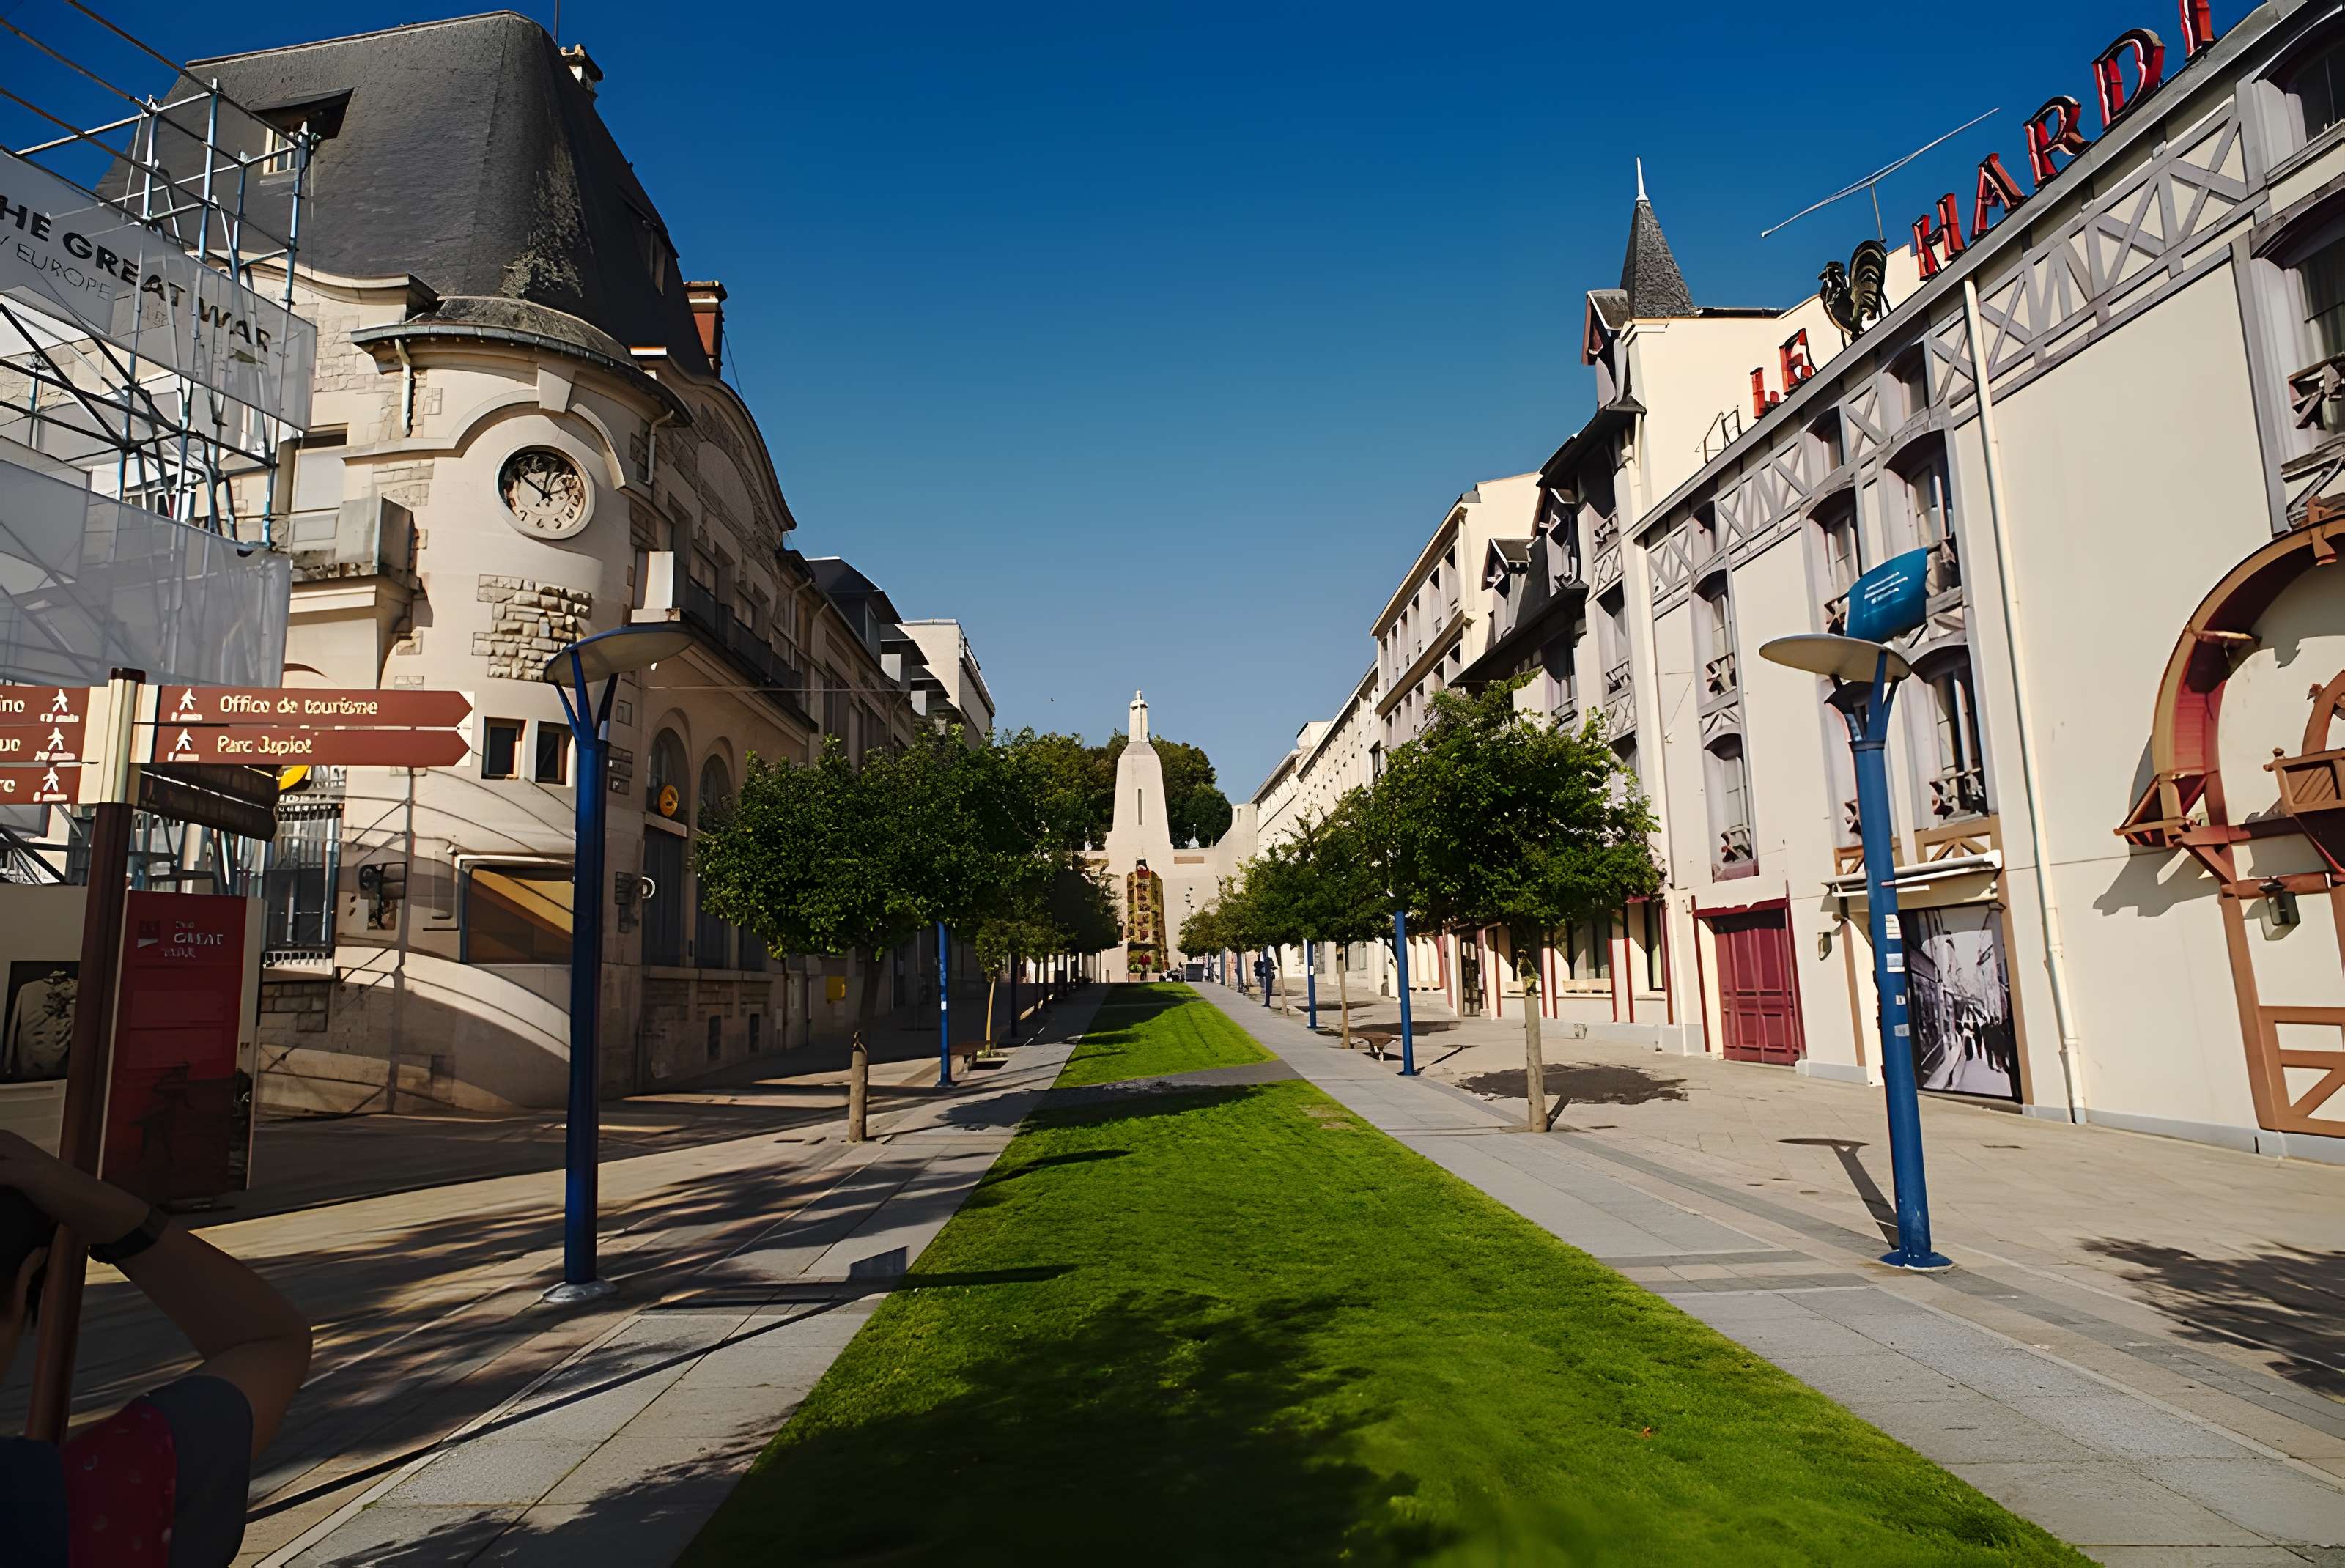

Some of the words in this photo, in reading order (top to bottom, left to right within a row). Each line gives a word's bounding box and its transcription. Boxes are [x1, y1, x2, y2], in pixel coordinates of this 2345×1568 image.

[16, 243, 113, 302] EUROPE
[62, 232, 186, 308] GREAT
[196, 296, 271, 352] WAR
[1750, 328, 1813, 419] LE
[220, 695, 270, 714] Office
[276, 697, 298, 714] de
[304, 697, 378, 716] tourisme
[217, 735, 254, 753] Parc
